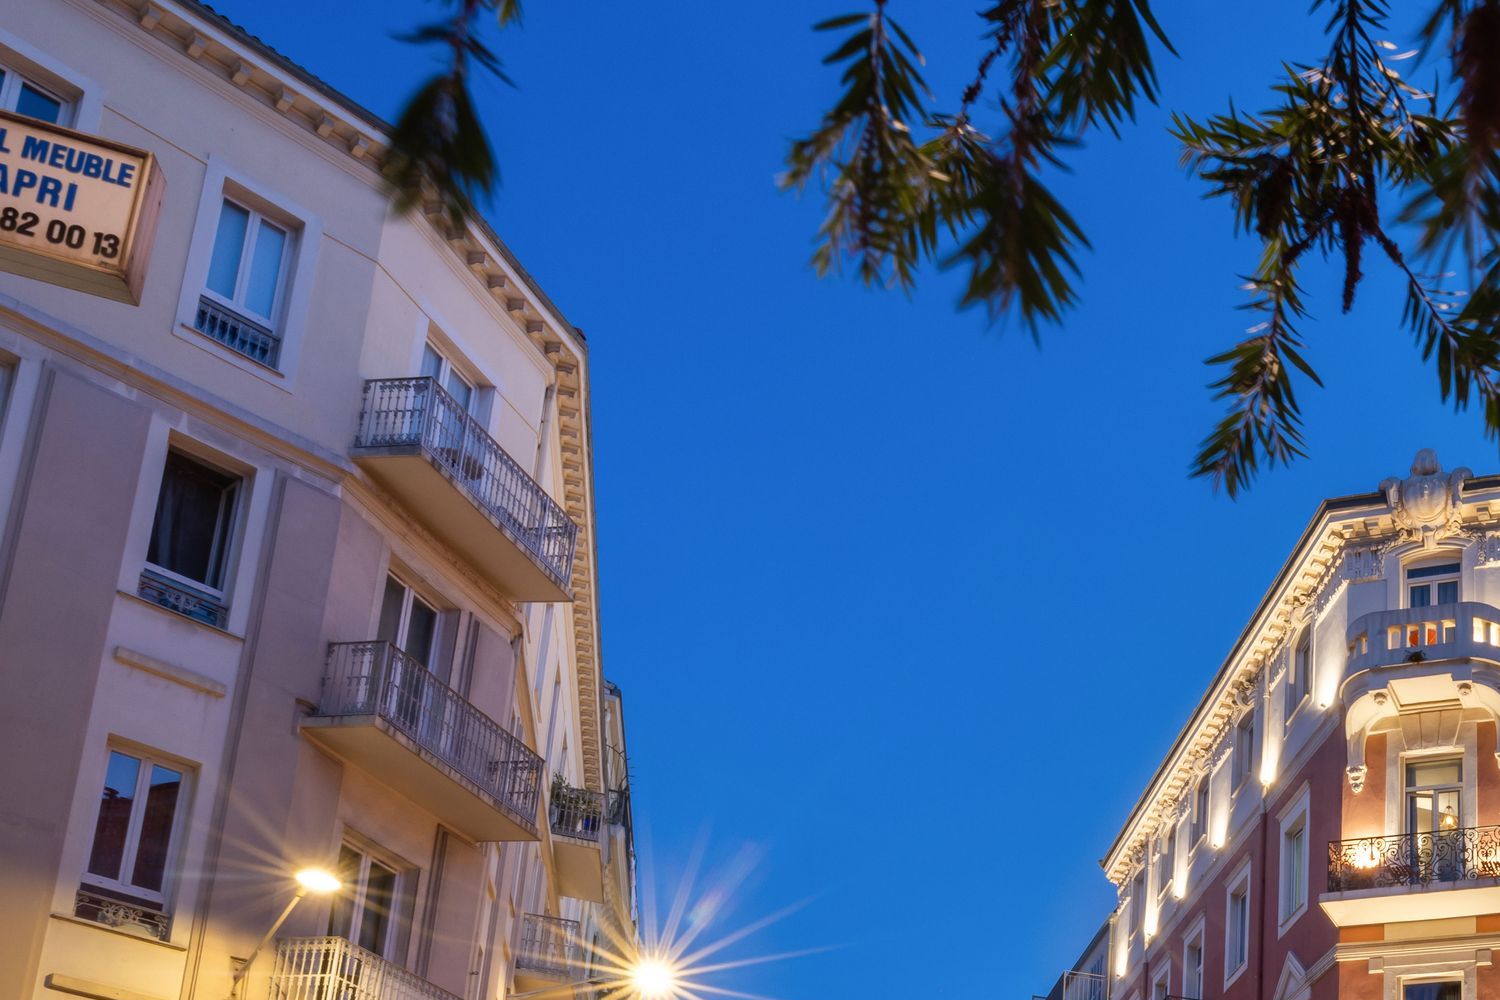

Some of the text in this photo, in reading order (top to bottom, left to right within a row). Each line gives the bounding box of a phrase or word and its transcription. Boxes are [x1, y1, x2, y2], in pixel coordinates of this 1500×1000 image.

[21, 135, 136, 188] MEUBLE
[0, 206, 120, 259] 82 00 13
